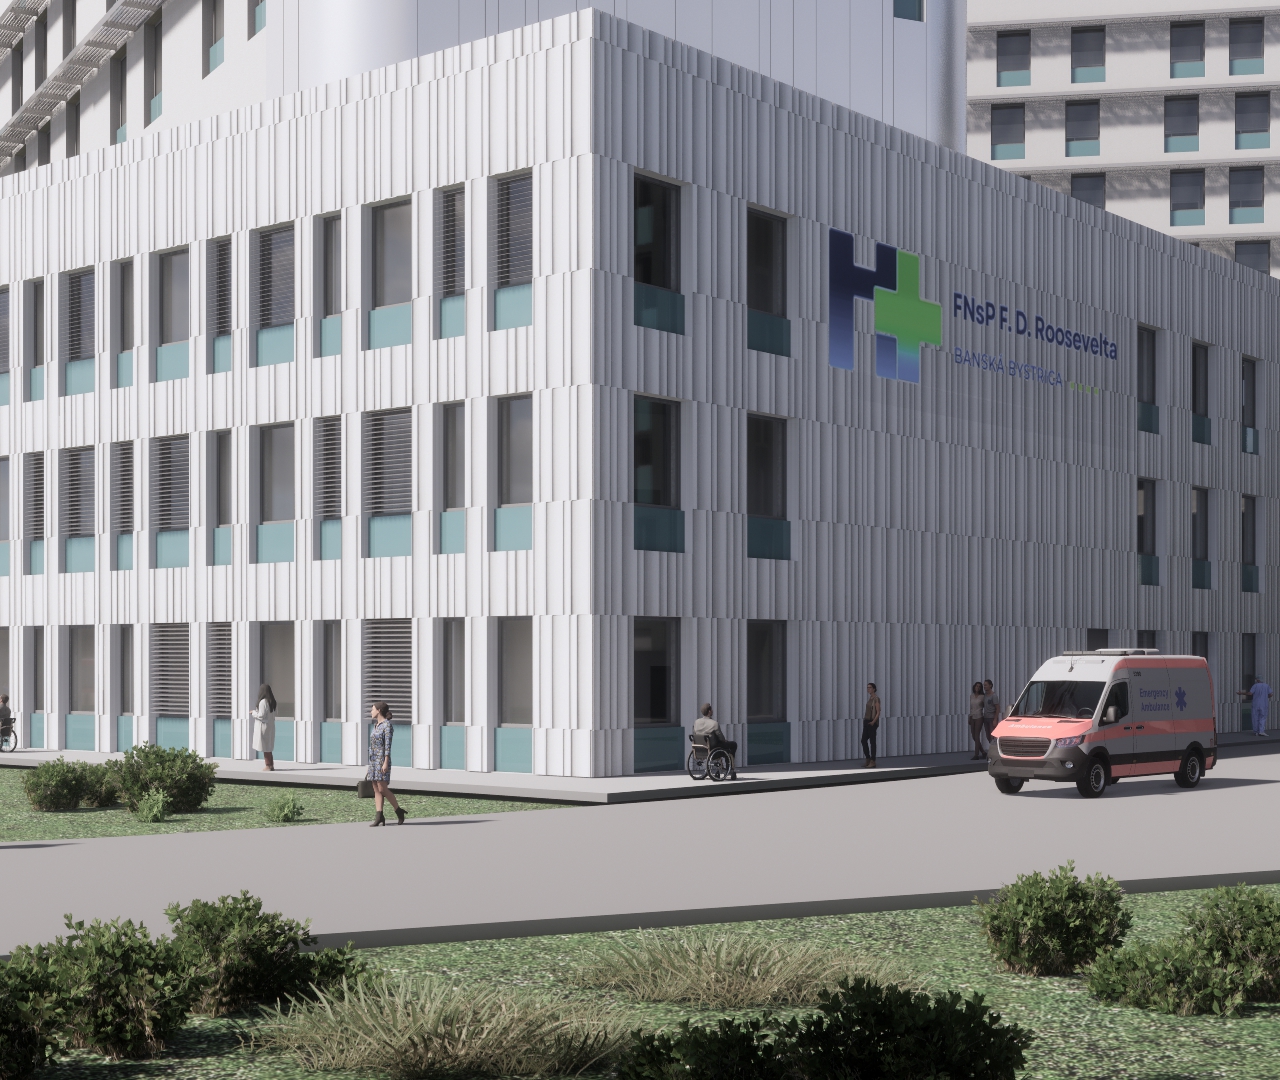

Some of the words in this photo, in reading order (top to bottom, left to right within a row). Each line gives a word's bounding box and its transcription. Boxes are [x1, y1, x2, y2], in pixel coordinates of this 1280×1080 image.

[953, 291, 996, 327] FNsP
[999, 306, 1012, 332] F.
[1016, 310, 1032, 338] D.
[1035, 316, 1118, 361] Roosevelta
[1008, 360, 1063, 388] BYSTRICA
[1139, 688, 1169, 700] Emergency
[1140, 702, 1170, 712] Ambulance
